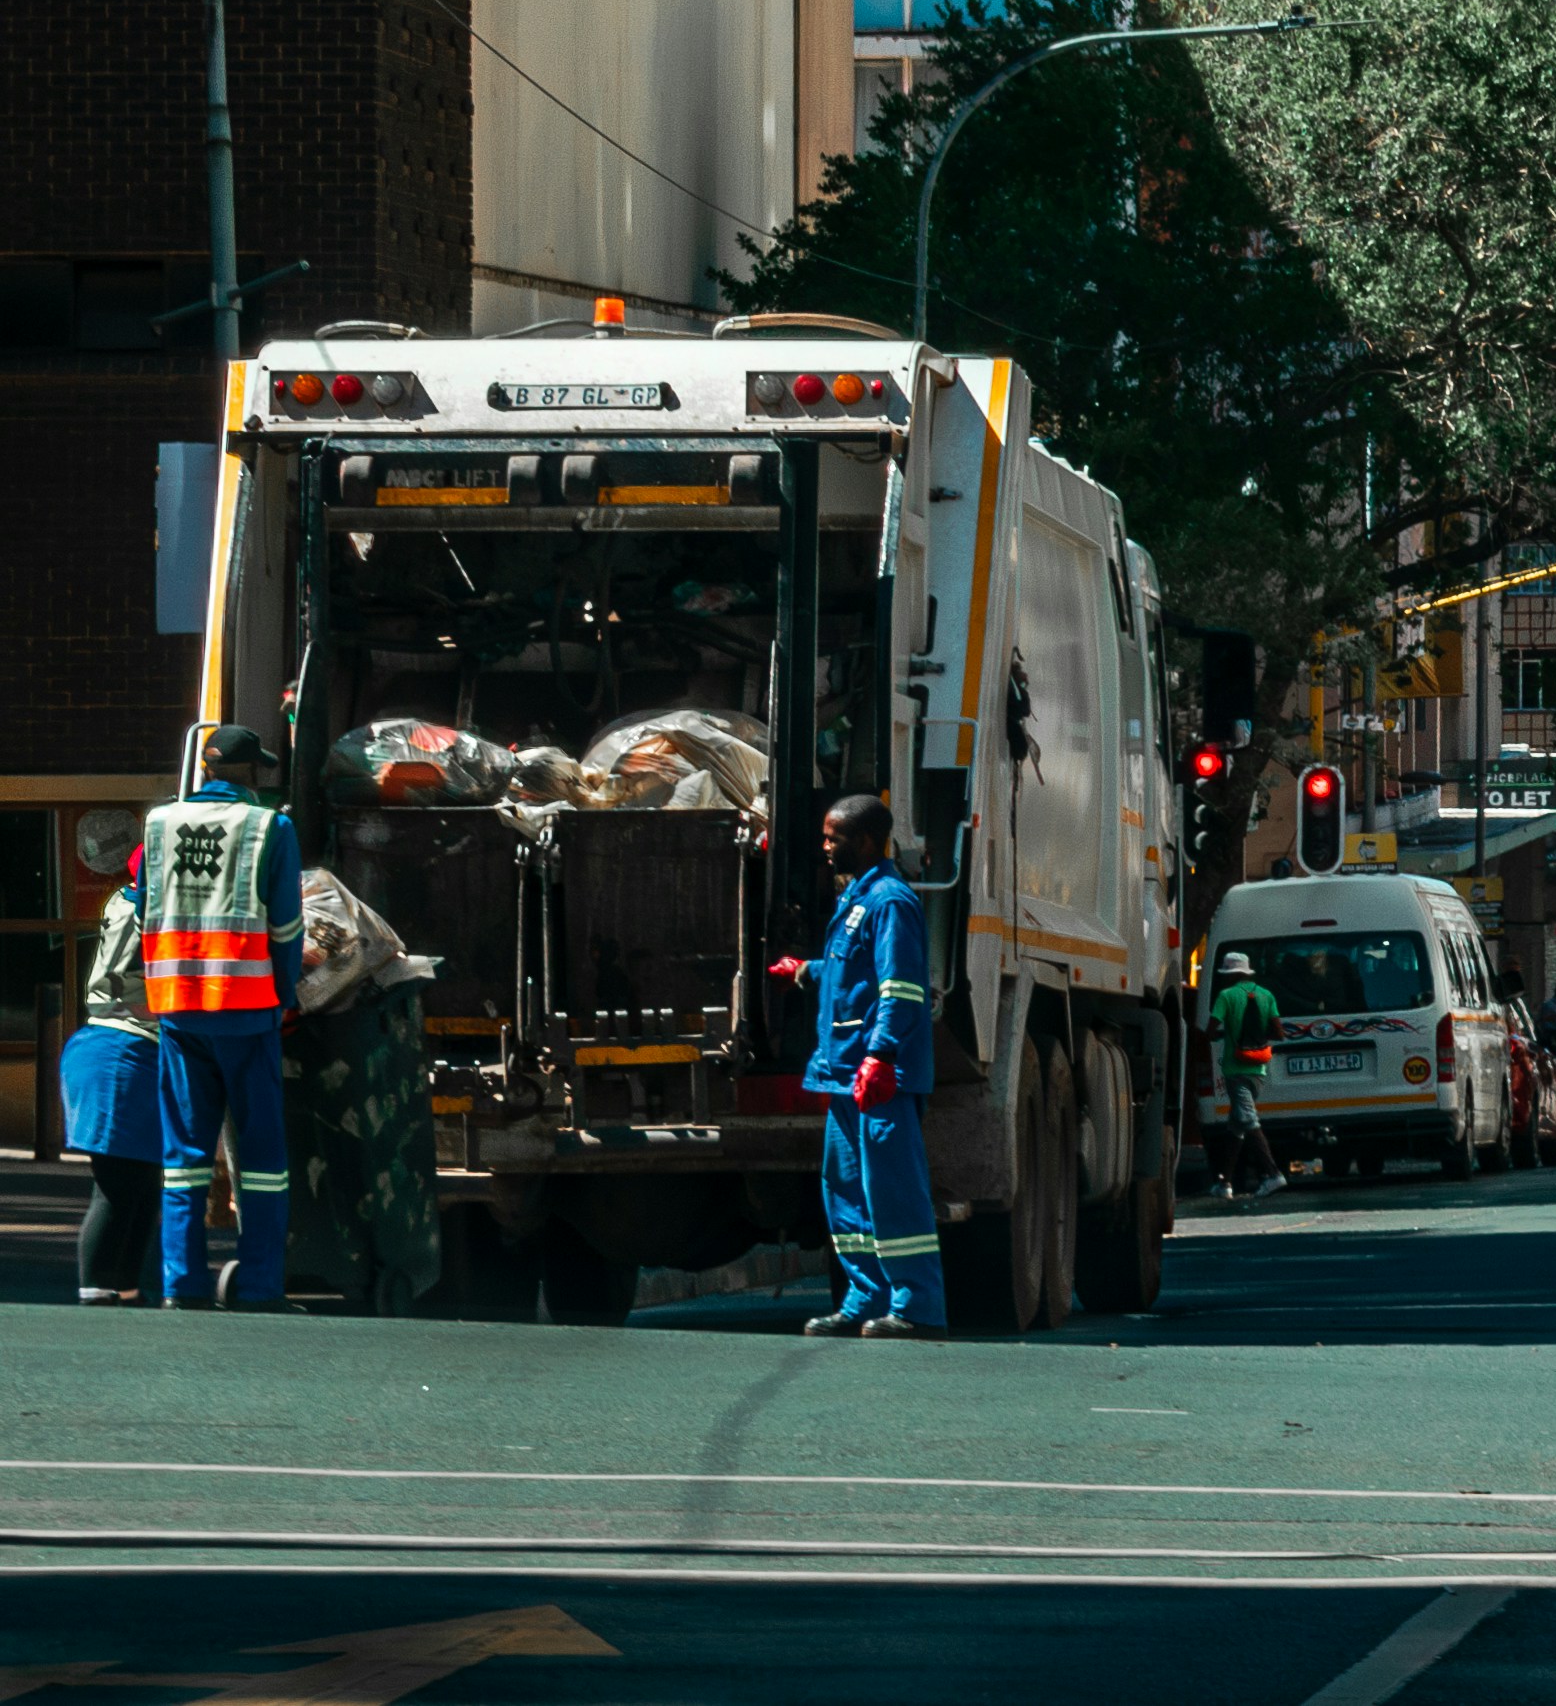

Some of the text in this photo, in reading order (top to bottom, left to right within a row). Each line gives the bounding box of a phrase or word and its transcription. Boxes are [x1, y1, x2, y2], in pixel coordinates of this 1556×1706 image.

[542, 387, 569, 405] 87
[582, 387, 609, 405] GL
[631, 387, 658, 405] GP
[454, 469, 500, 488] LIFT
[1510, 791, 1551, 806] LET
[184, 837, 215, 849] PIKI
[183, 852, 214, 865] TUP
